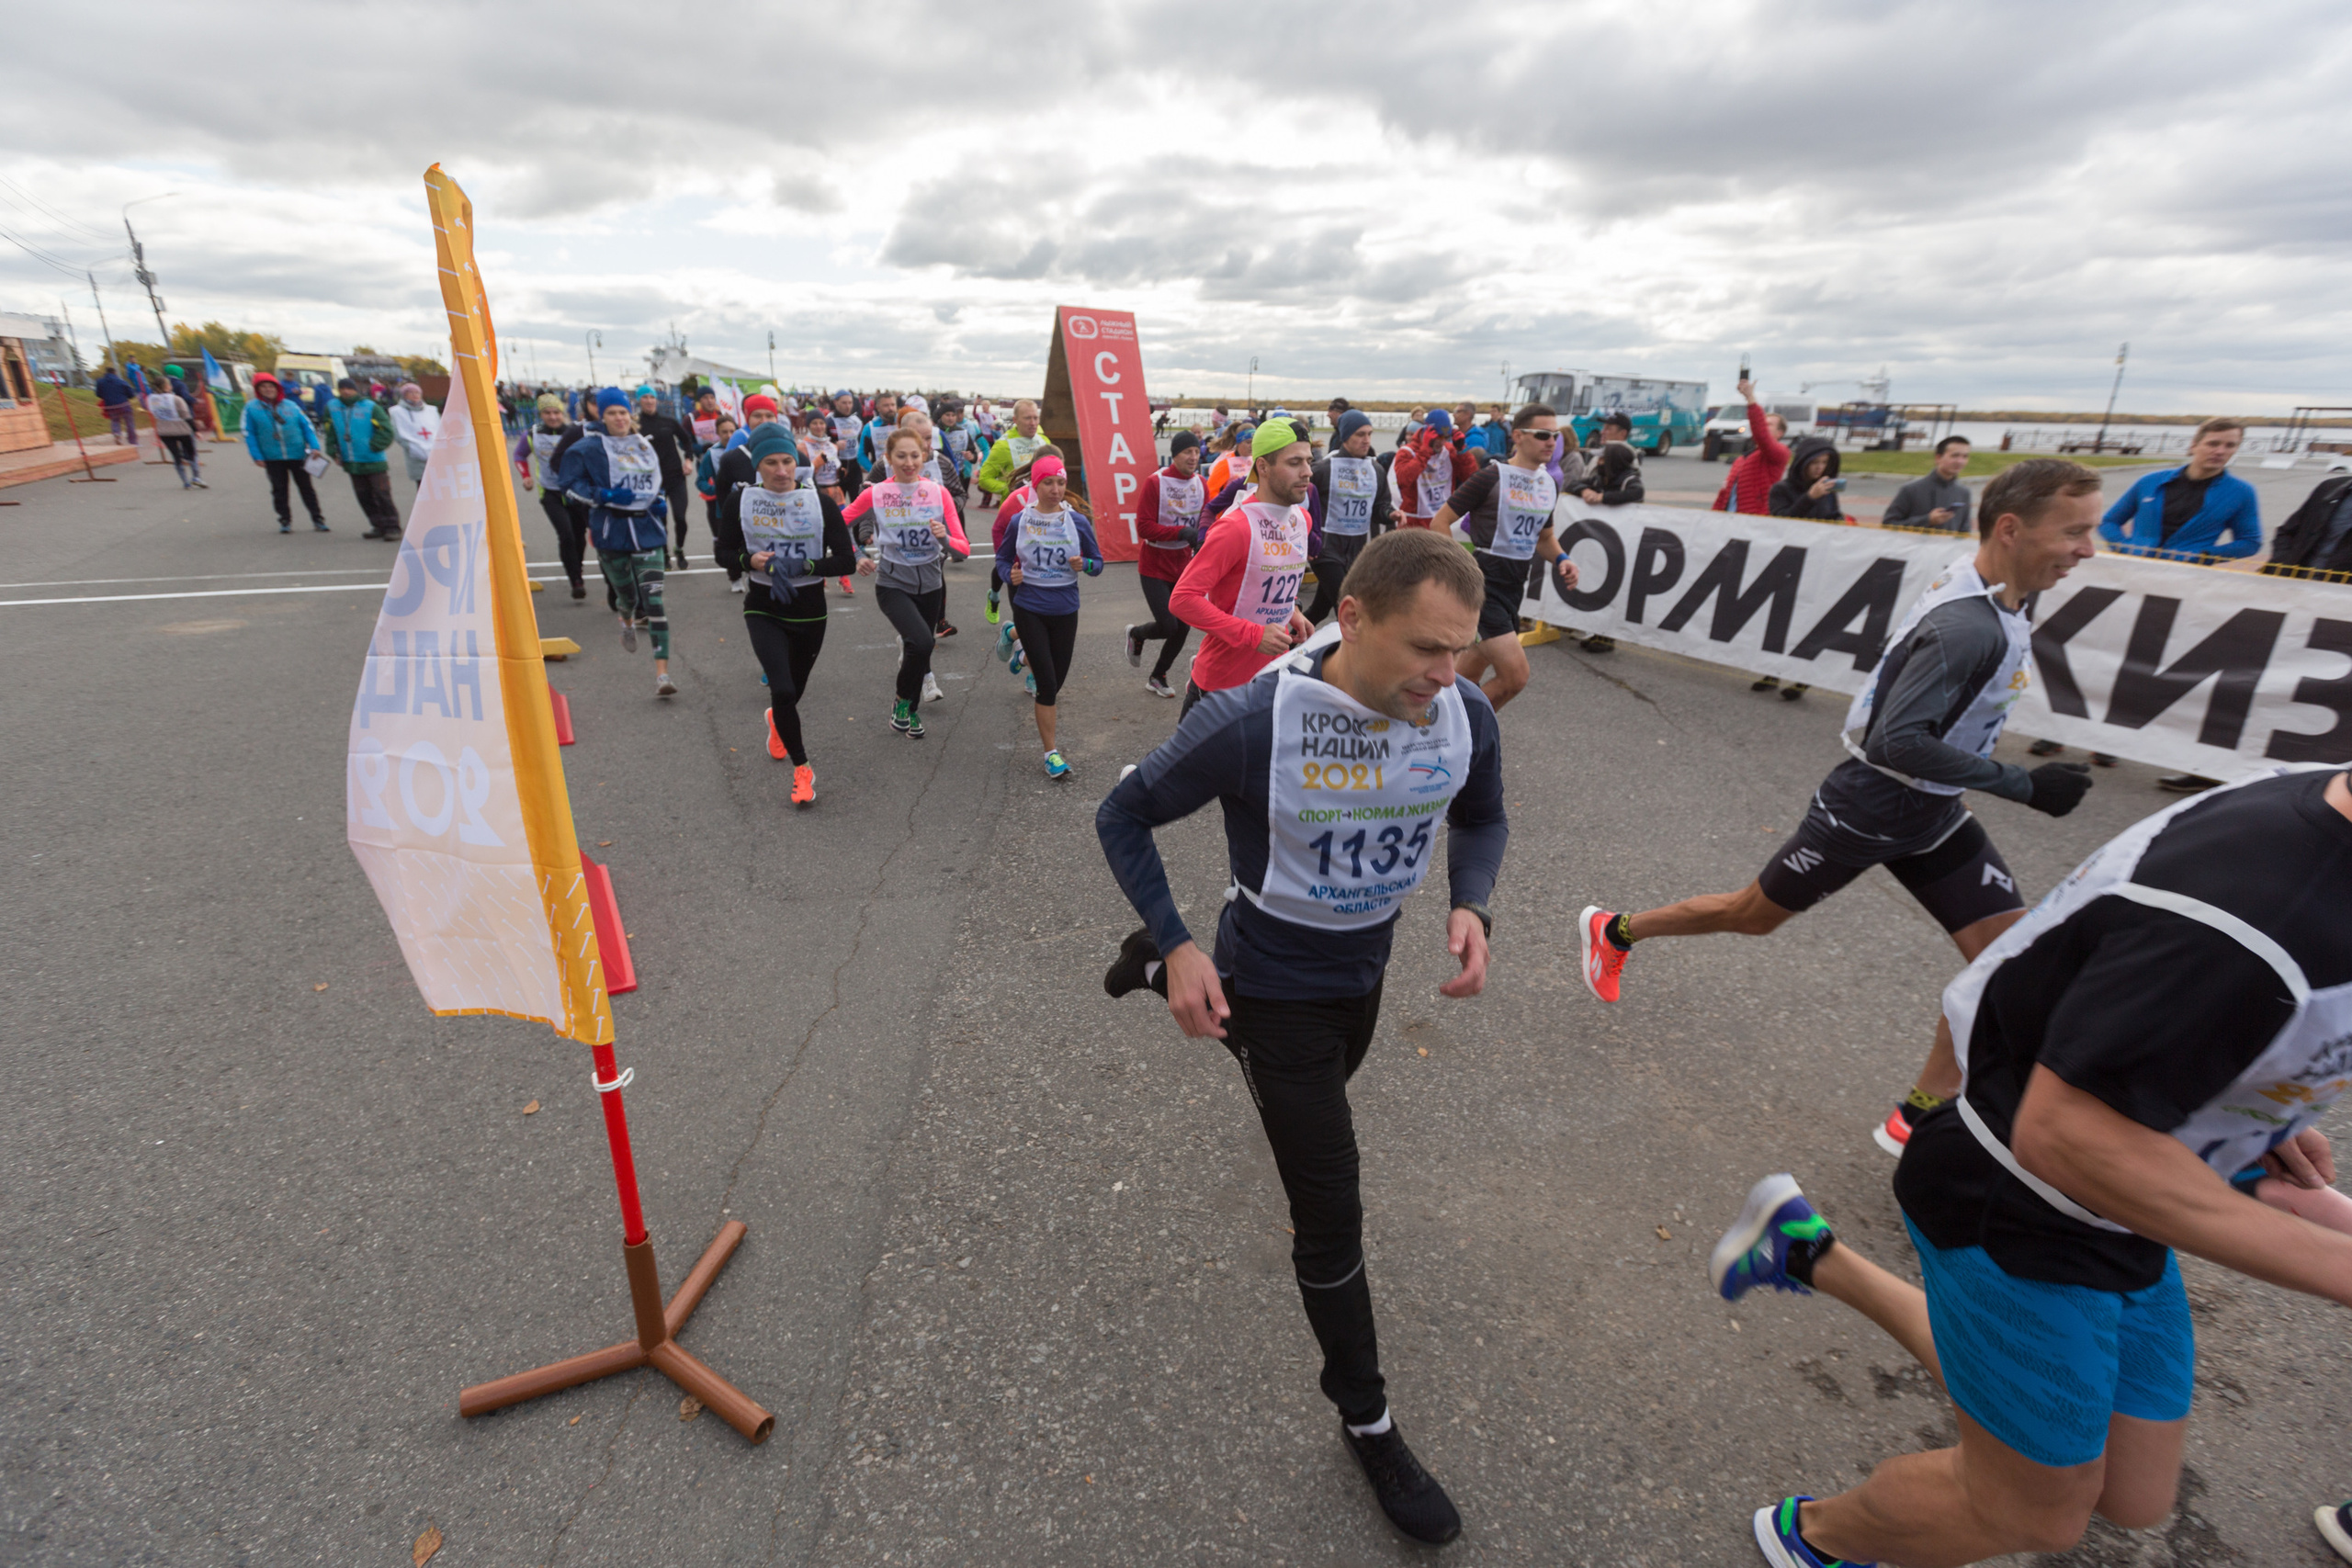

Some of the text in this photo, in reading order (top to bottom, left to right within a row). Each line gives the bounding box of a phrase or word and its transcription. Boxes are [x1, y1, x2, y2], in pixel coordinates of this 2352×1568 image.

[1094, 351, 1139, 545] СТАРТ
[752, 507, 786, 516] НАЦИИ
[885, 508, 911, 518] 2021
[1343, 500, 1368, 516] 178
[752, 515, 785, 528] 2021
[897, 528, 931, 547] 182
[765, 541, 808, 560] 175
[1033, 547, 1067, 567] 173
[1263, 542, 1292, 557] 2021
[1261, 572, 1304, 604] 1227
[1526, 518, 1907, 673] ОРМА
[1301, 737, 1390, 761] НАЦИИ
[1301, 761, 1384, 791] 2021
[1298, 808, 1343, 823] СПОРТ
[1352, 804, 1405, 822] НОРМА
[1309, 818, 1434, 878] 1135
[1308, 872, 1418, 901] АРХАНГЕЛЬСКАЯ
[1333, 897, 1392, 915] ОБЛАСТЬ
